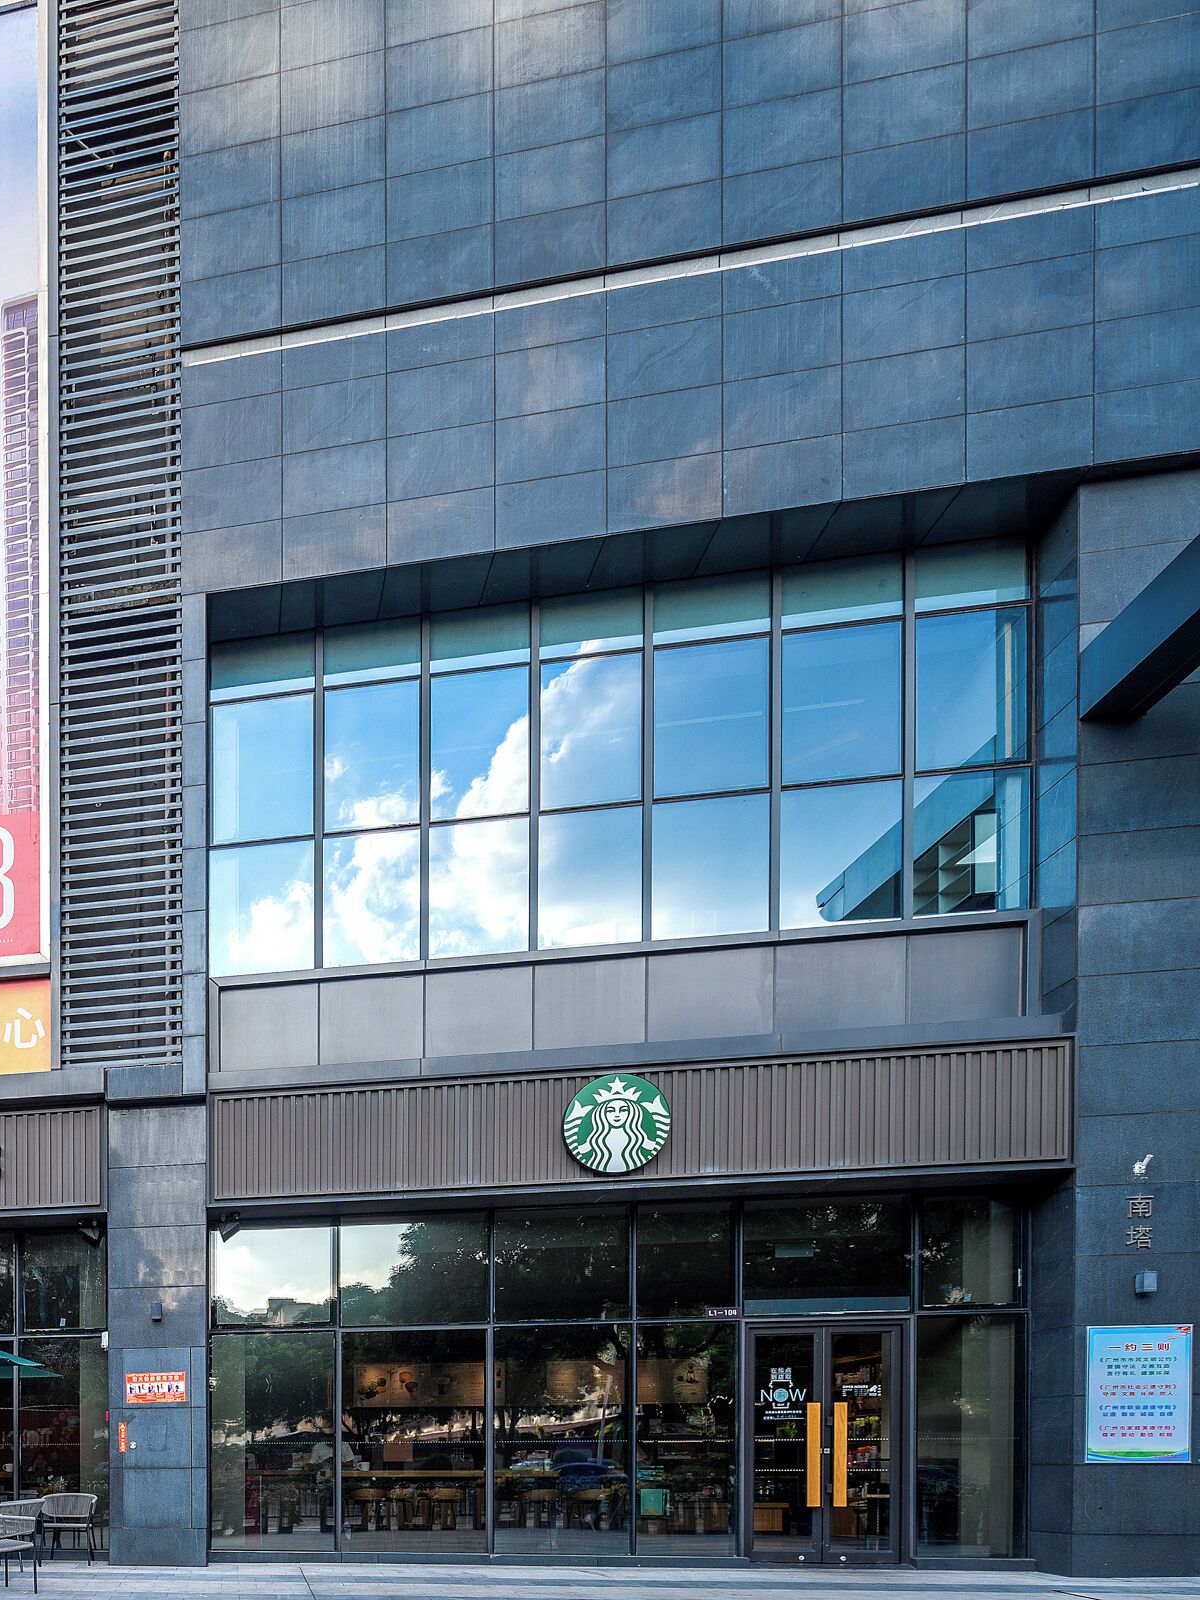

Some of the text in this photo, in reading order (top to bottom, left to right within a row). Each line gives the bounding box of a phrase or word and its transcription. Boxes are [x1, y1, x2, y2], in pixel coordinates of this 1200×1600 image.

[1125, 1193, 1155, 1249] 南塔
[1108, 1342, 1171, 1352] 一约三则
